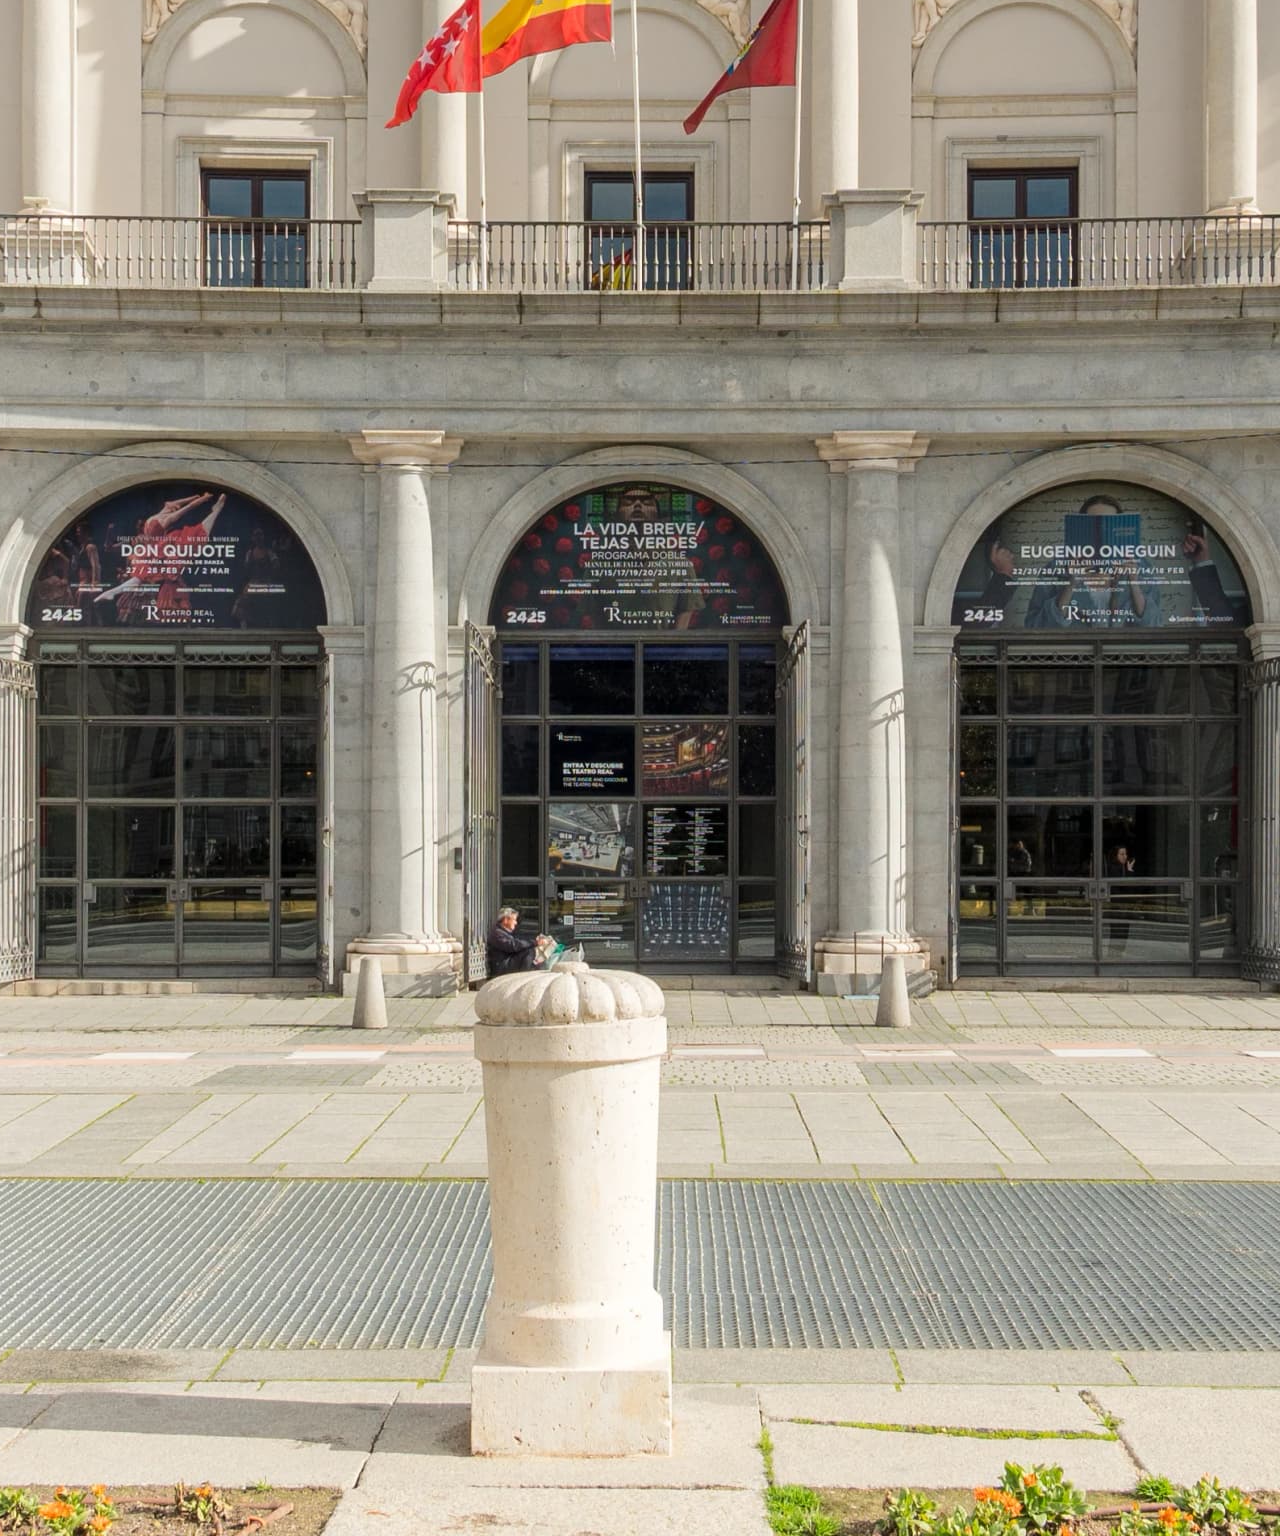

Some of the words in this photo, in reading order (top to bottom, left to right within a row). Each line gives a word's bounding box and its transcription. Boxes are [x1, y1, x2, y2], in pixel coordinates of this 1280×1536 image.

[573, 523, 595, 535] LA
[600, 523, 638, 535] VIDA
[643, 521, 705, 537] BREVE/
[580, 537, 629, 550] TEJAS
[633, 537, 698, 549] VERDES
[121, 544, 159, 558] DON
[163, 544, 236, 558] QUIJOTE
[591, 551, 650, 560] PROGRAMA
[652, 551, 686, 560] DOBLE
[1020, 545, 1095, 559] EUGENIO
[1099, 545, 1176, 559] ONEGUIN
